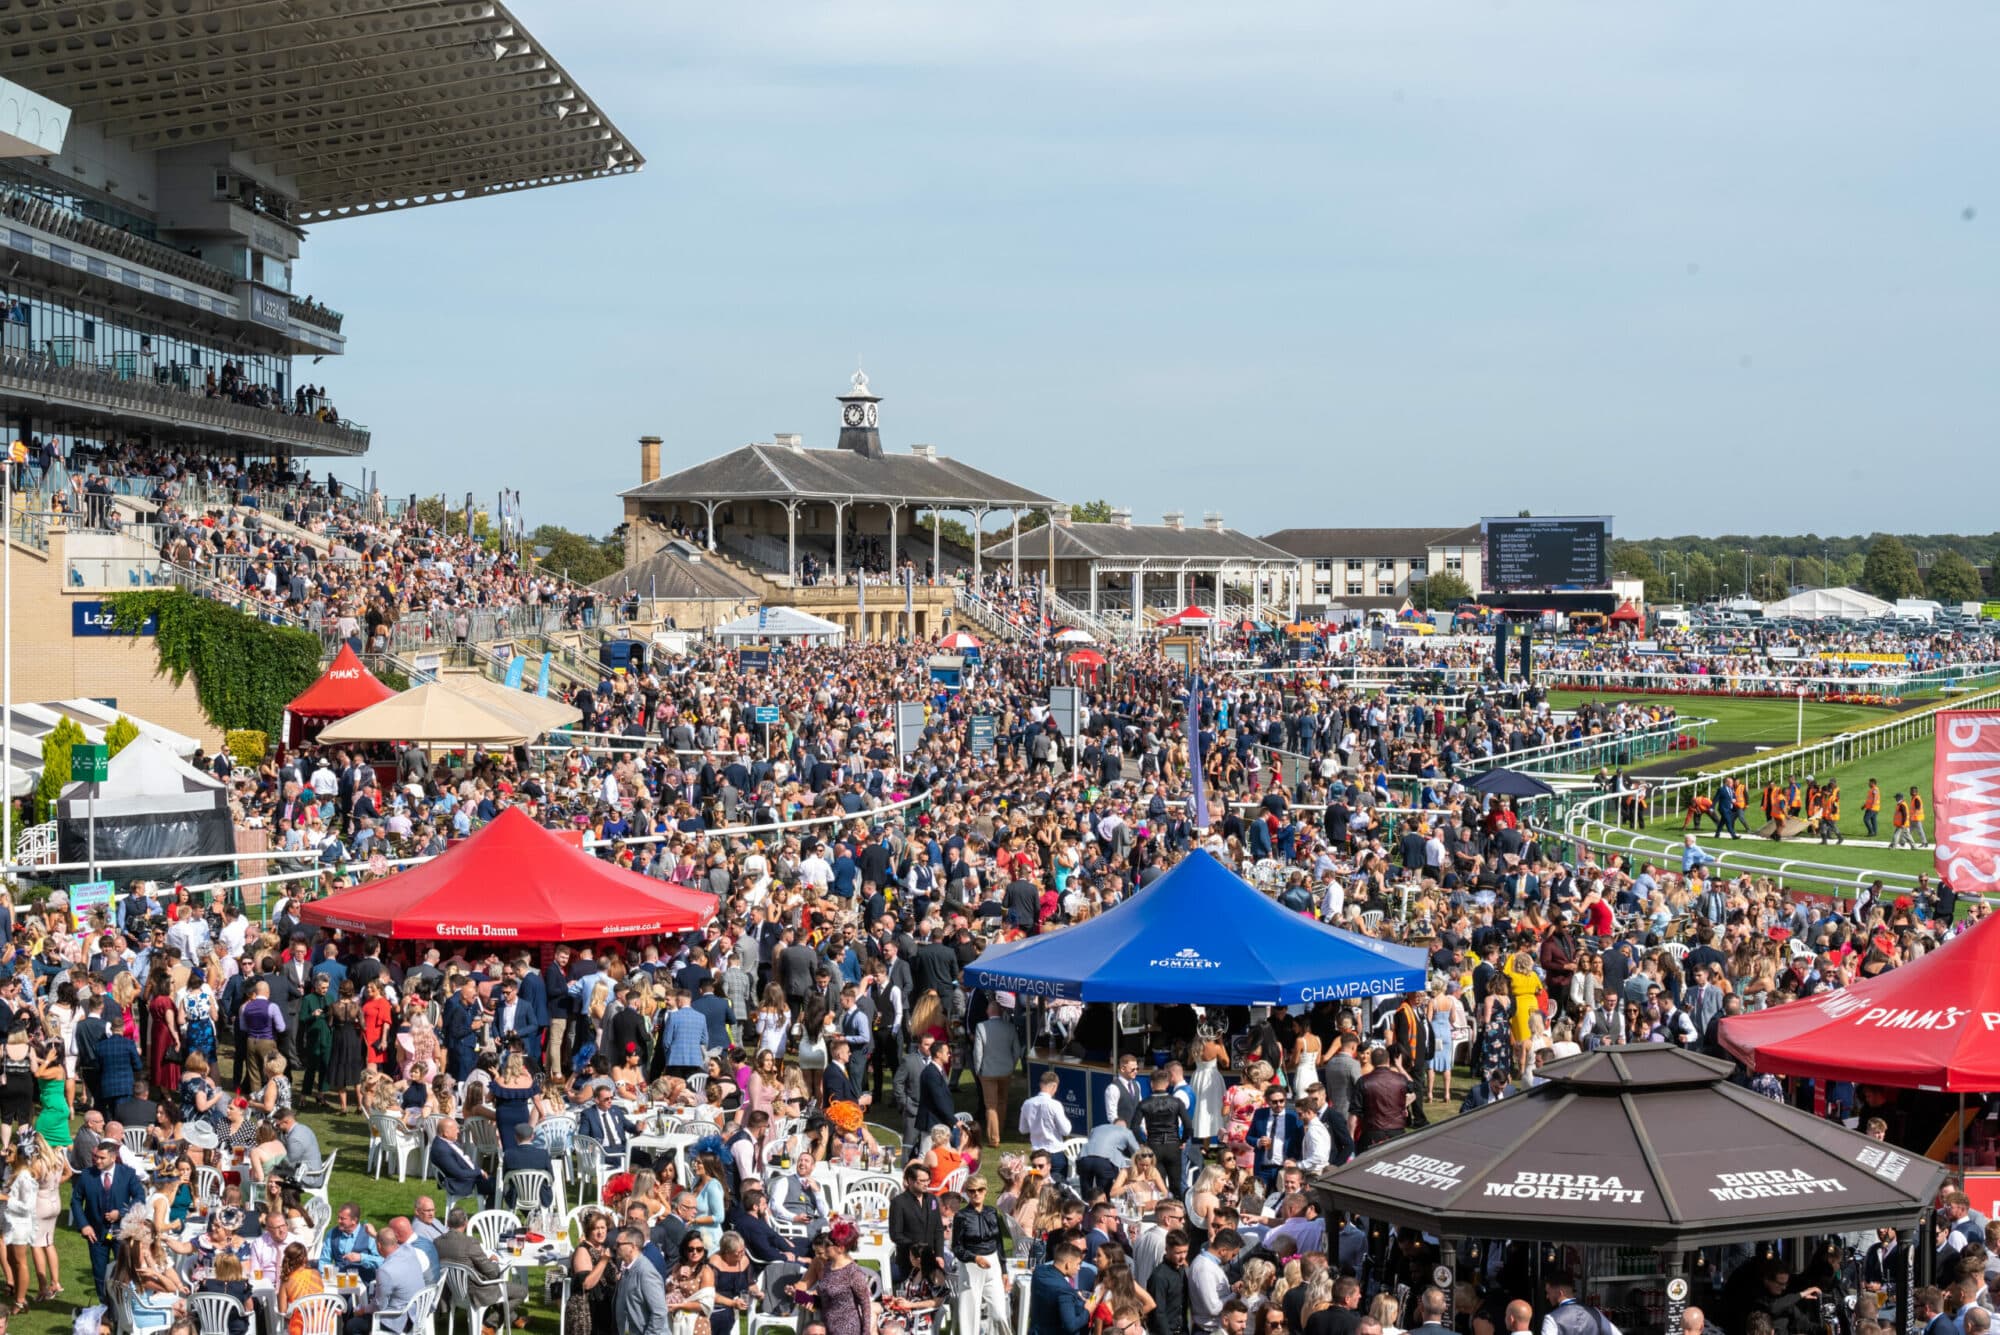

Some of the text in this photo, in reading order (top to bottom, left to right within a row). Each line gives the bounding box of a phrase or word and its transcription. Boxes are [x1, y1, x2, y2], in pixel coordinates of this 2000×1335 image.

[436, 923, 518, 937] Estrella Damm
[602, 922, 661, 934] drinkaware.co.uk
[1150, 960, 1222, 968] POMMERY
[979, 971, 1065, 998] CHAMPAGNE
[1300, 977, 1405, 1002] CHAMPAGNE
[1855, 1007, 1971, 1030] PIMM'S
[1364, 1161, 1462, 1191] MORETTI
[1397, 1154, 1465, 1177] BIRRA
[1514, 1172, 1623, 1189] BIRRA
[1716, 1168, 1815, 1187] BIRRA
[1483, 1183, 1645, 1204] MORETTI
[1708, 1178, 1848, 1201] MORETTI
